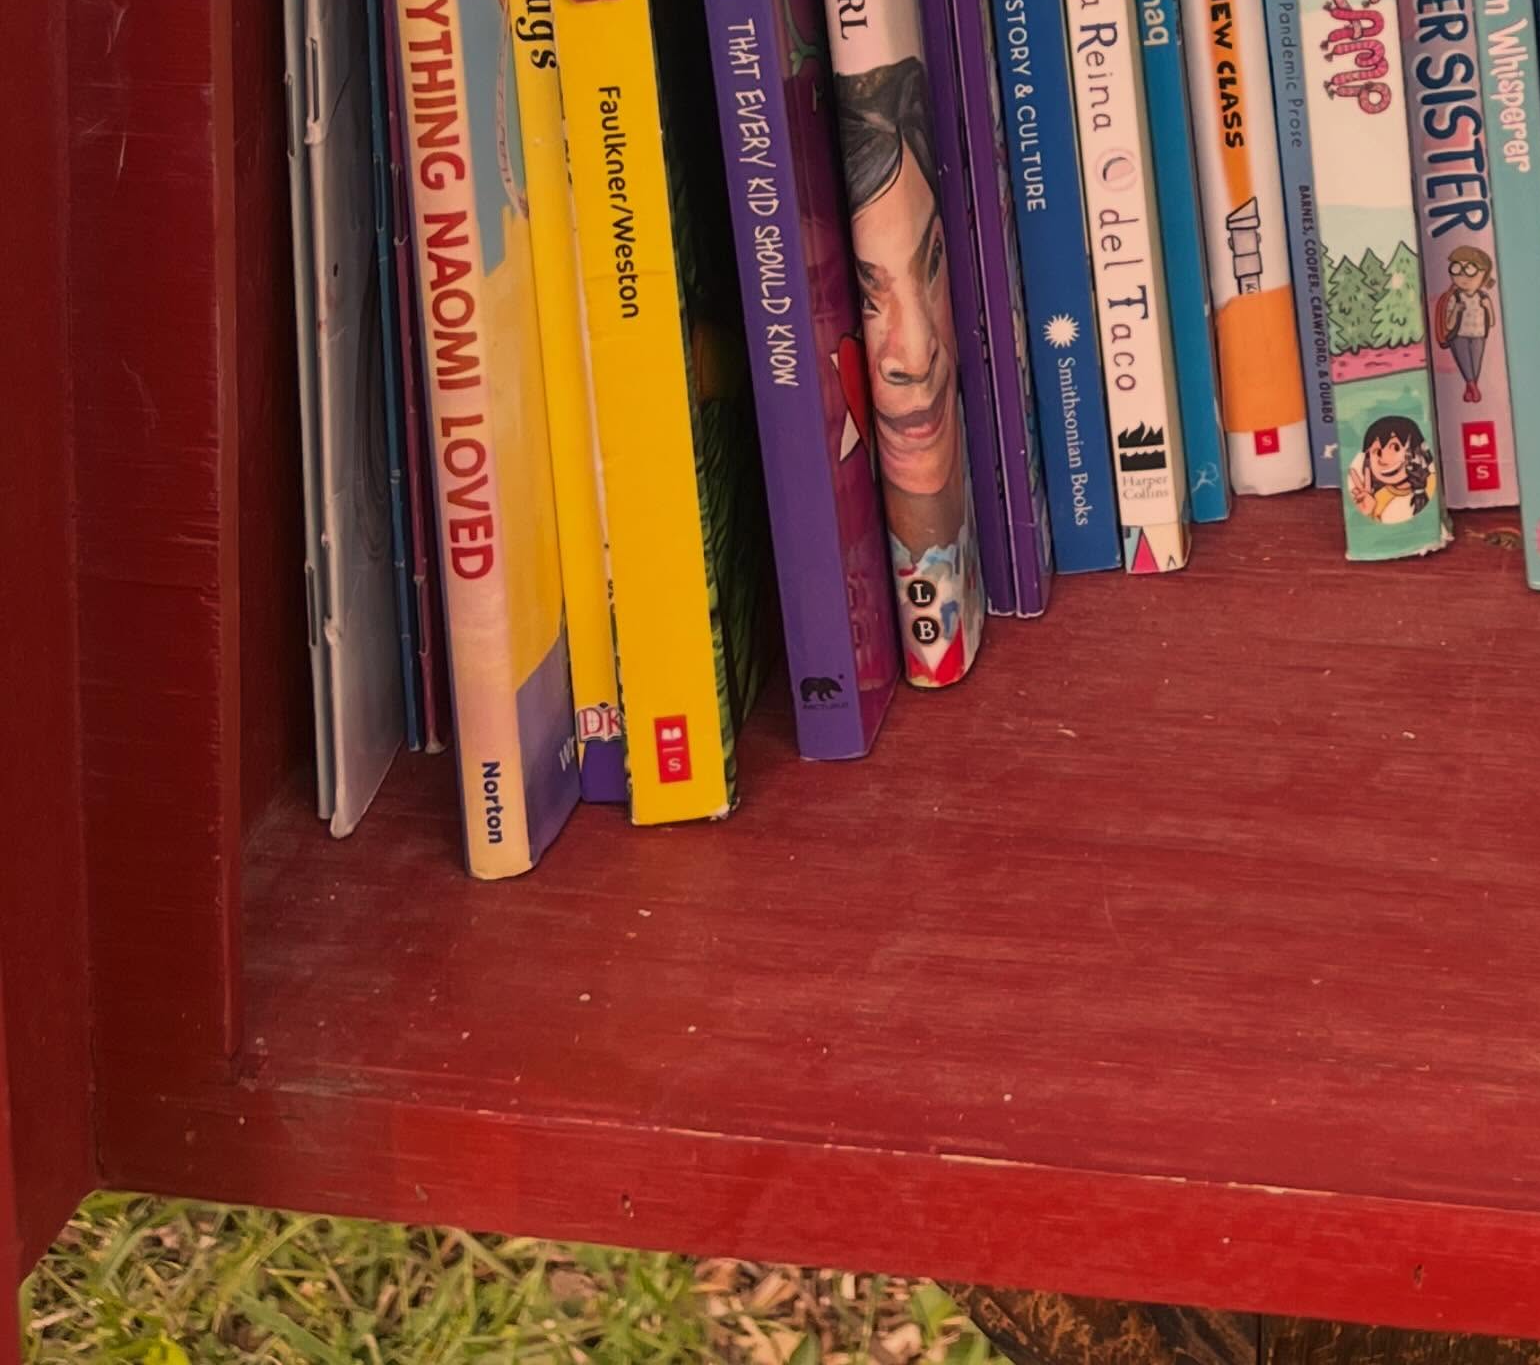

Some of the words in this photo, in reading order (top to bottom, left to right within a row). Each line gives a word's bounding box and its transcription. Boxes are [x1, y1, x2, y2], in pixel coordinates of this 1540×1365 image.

[1014, 83, 1034, 98] &
[1216, 60, 1244, 149] CLASS
[1279, 2, 1298, 92] Pandemic
[1486, 18, 1531, 173] Whisperer
[1017, 104, 1047, 212] CULTURE
[1287, 94, 1305, 148] Prose
[1414, 51, 1489, 238] SISTER
[599, 85, 639, 319] Faulkner/Weston
[423, 210, 481, 391] NAOMI
[439, 413, 494, 581] LOVED
[1057, 357, 1083, 468] Smithsonian
[1070, 471, 1089, 526] Books
[481, 760, 504, 844] Norton
